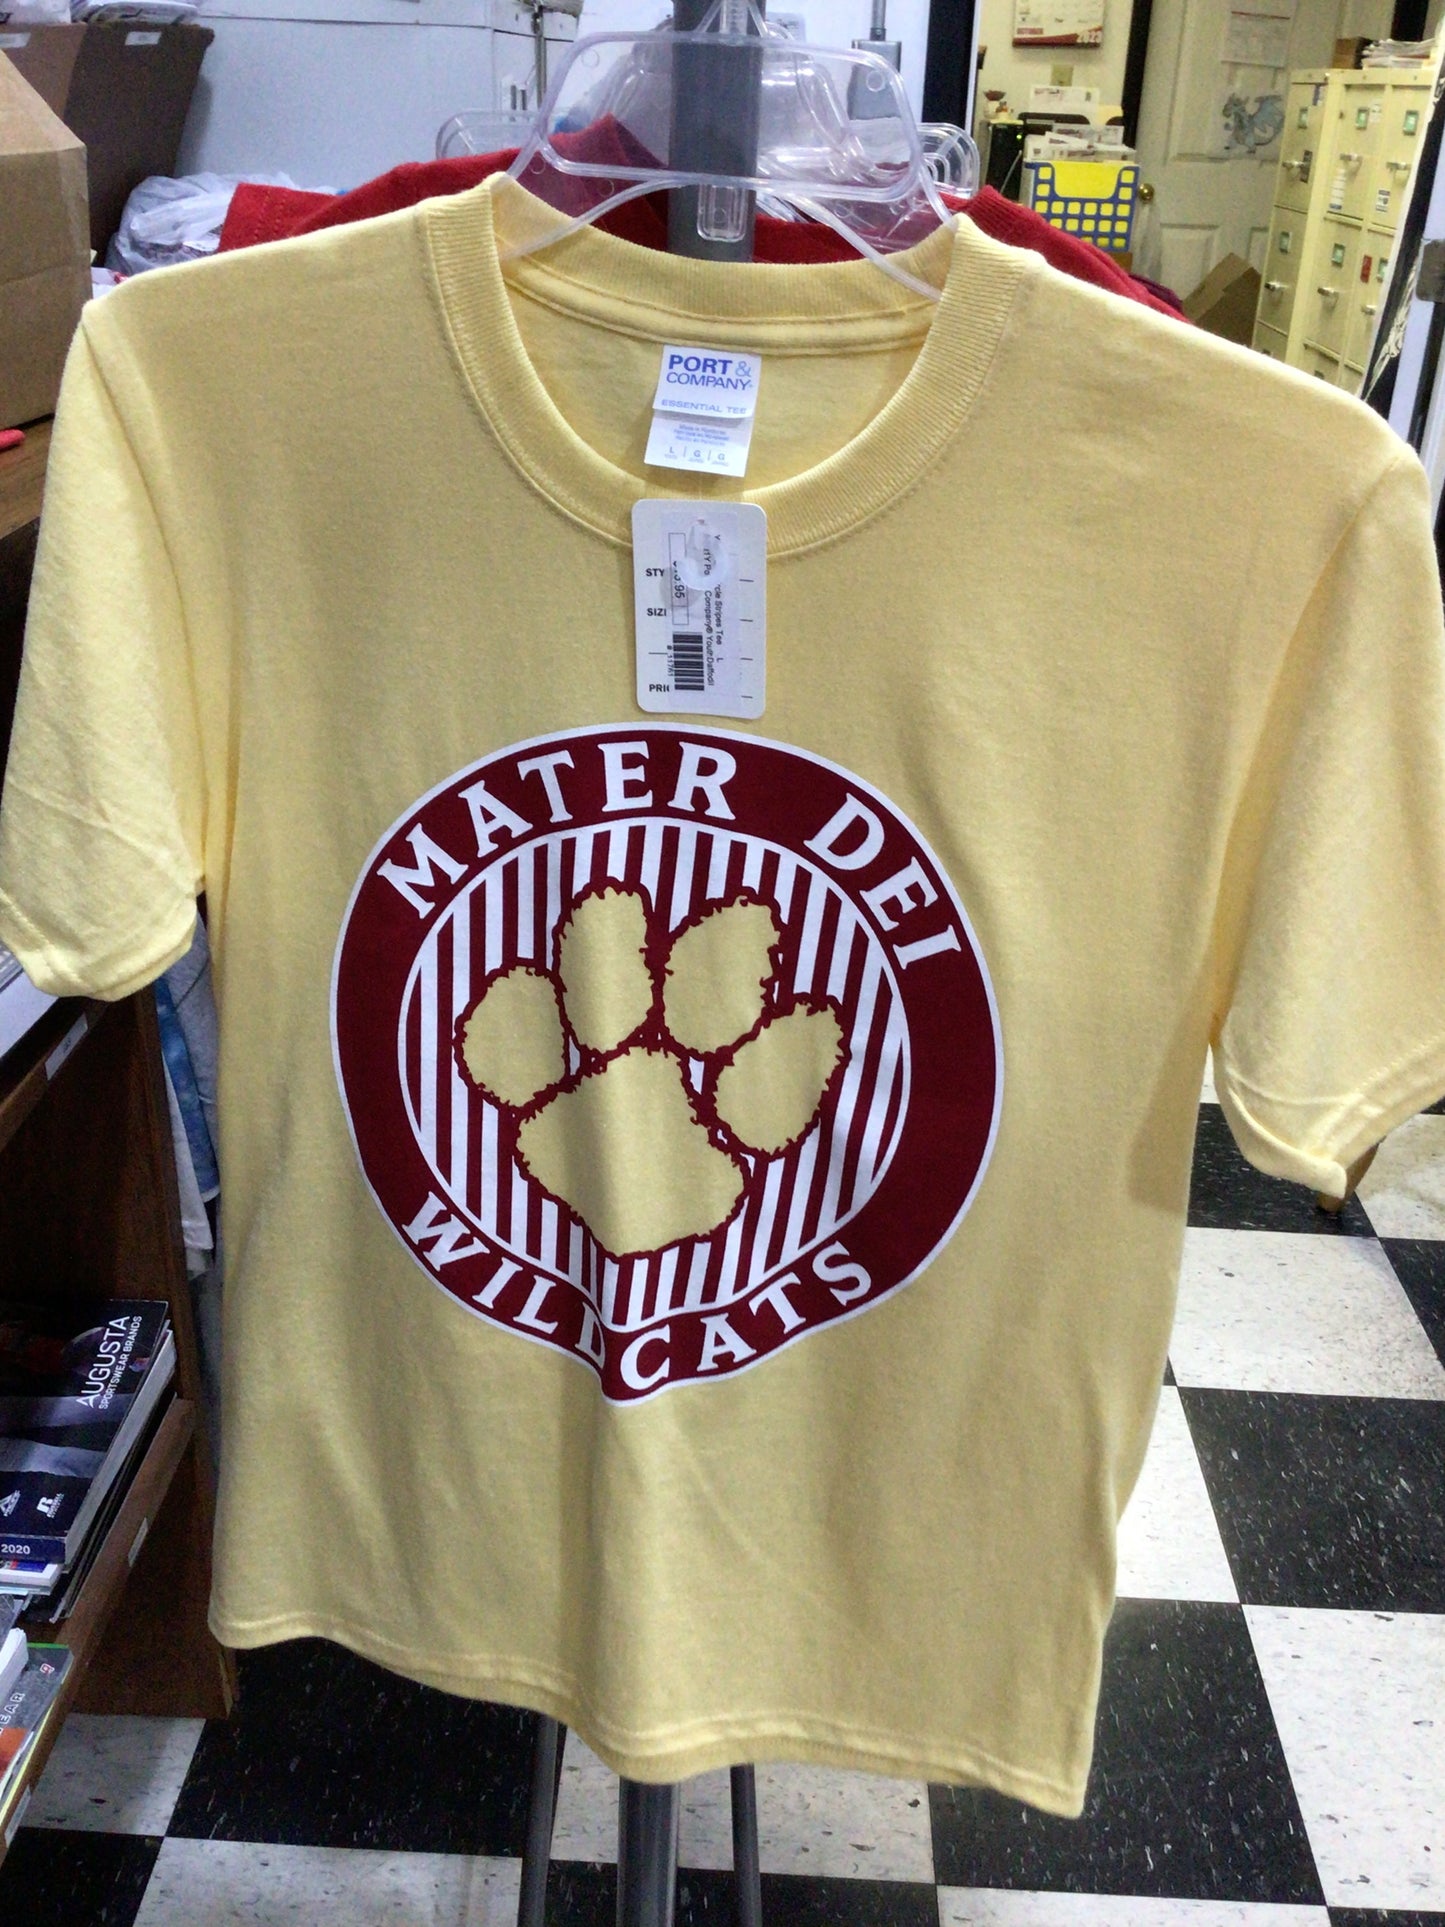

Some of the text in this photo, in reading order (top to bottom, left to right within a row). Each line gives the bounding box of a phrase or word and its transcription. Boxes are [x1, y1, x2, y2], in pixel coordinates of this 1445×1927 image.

[668, 354, 752, 377] PORT &
[661, 399, 748, 414] ESSENTIAL TEE
[645, 567, 665, 577] STY
[716, 630, 724, 645] Tee
[649, 683, 670, 692] PRI
[378, 740, 962, 970] MATER DEI
[76, 1316, 131, 1408] AUGUSTA
[98, 1315, 143, 1410] SPORTSWEAR BRANDS
[0, 1543, 31, 1555] 2020
